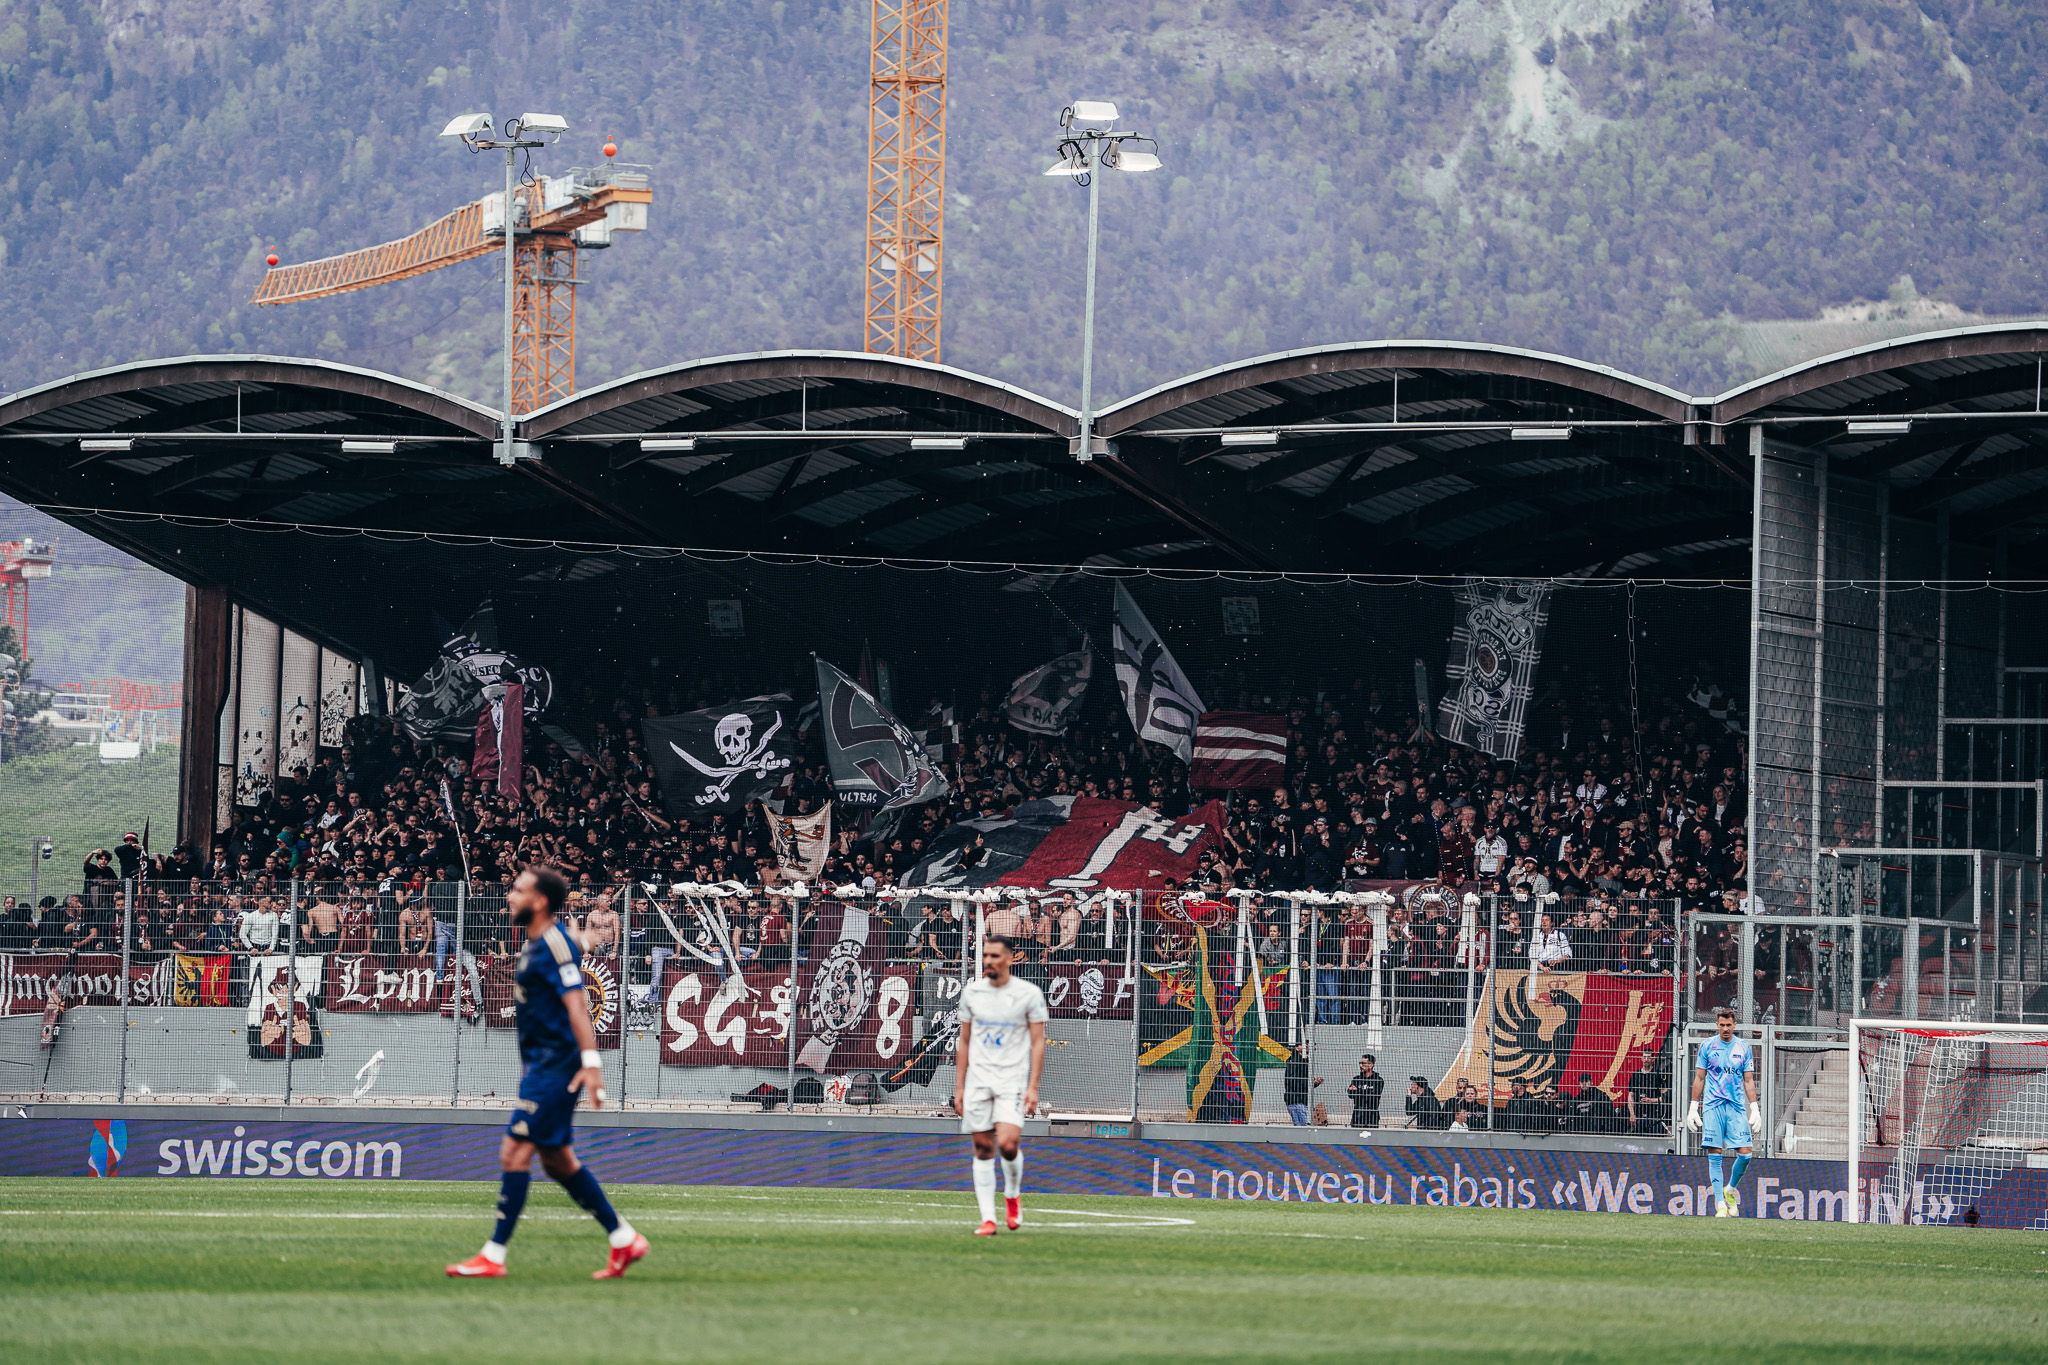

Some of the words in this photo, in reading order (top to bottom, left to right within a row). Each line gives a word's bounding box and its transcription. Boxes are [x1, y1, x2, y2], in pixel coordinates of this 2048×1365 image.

[838, 791, 878, 804] ULTRAS
[1723, 1066, 1742, 1076] MSC
[1095, 1123, 1128, 1136] telsa
[157, 1125, 402, 1177] swisscom
[1152, 1157, 1196, 1199] Le
[1211, 1168, 1393, 1205] nouveau
[1410, 1162, 1536, 1209] rabais
[1667, 1181, 1741, 1218] ar
